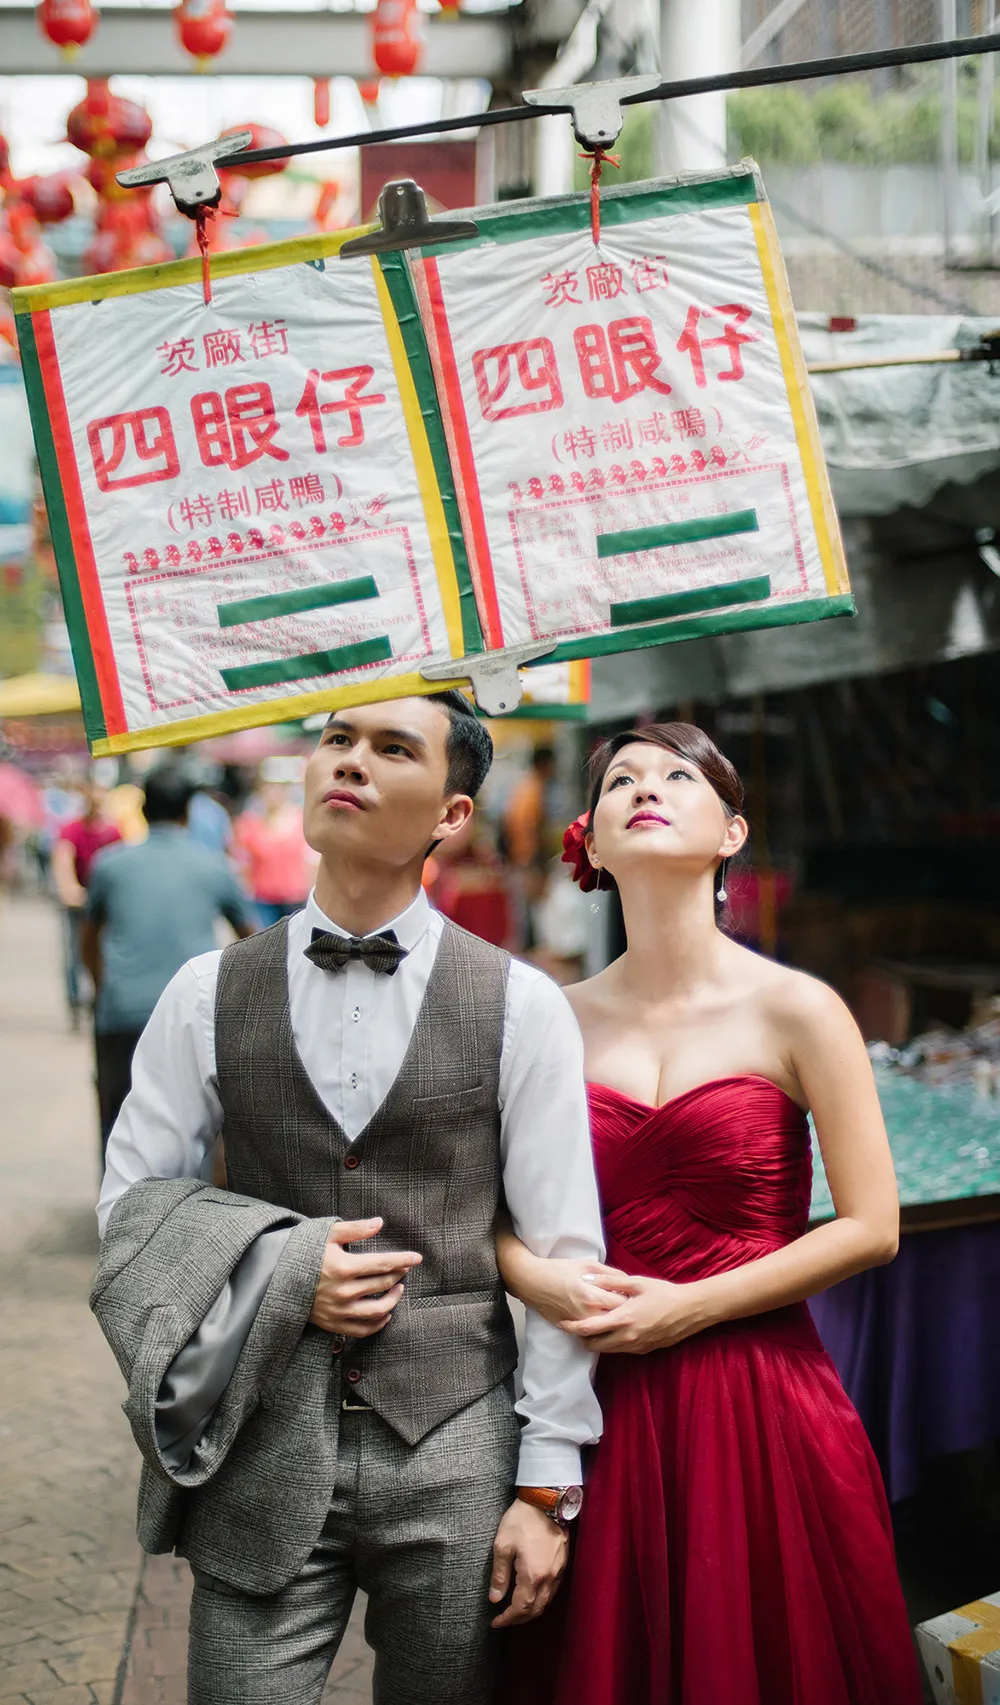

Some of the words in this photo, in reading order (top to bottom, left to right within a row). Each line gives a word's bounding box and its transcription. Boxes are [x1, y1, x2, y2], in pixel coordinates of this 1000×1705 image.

[540, 255, 670, 309] 茨廠街
[157, 319, 289, 377] 茨廠街
[471, 303, 765, 423] 四眼仔
[86, 363, 387, 493] 四眼仔
[167, 471, 343, 534] (特制咸鴨)
